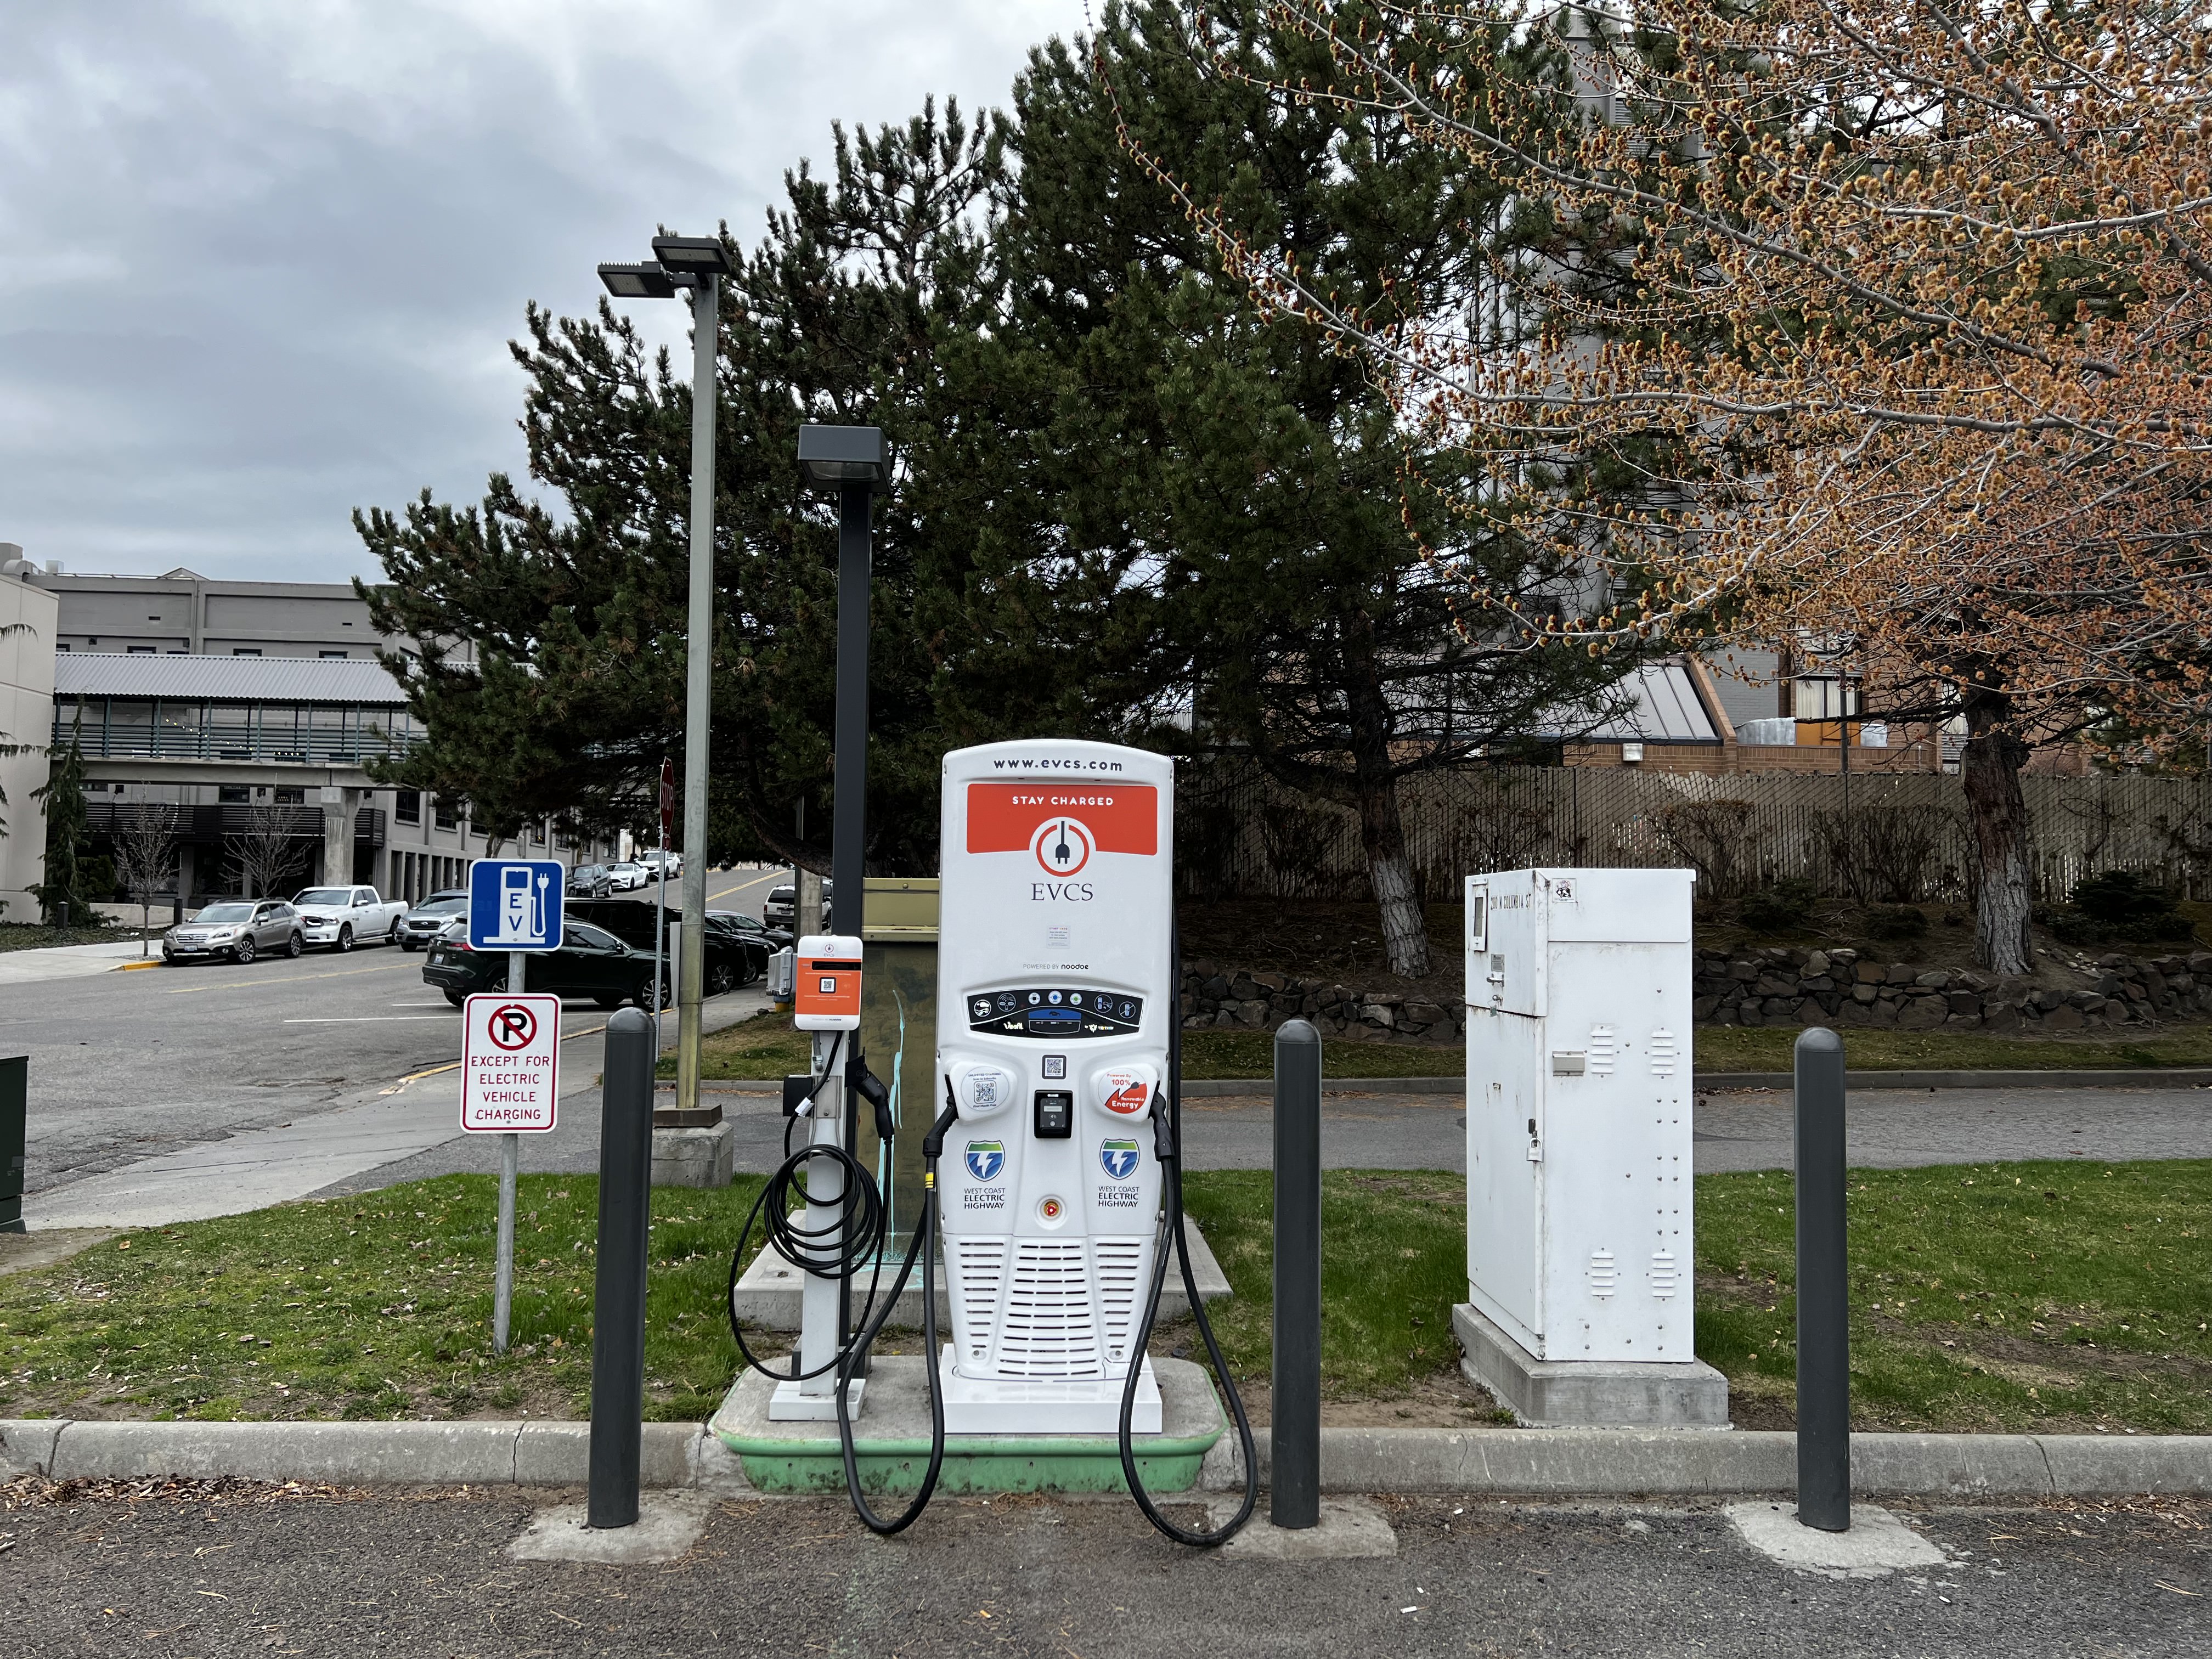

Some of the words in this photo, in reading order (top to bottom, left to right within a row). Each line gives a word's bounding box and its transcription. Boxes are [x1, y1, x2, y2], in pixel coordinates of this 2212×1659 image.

[994, 759, 1122, 771] www.evcs.com
[661, 781, 673, 811] STOP
[1012, 796, 1045, 805] STAY
[1051, 797, 1114, 806] CHARGED
[1031, 883, 1093, 901] EVCS
[1499, 896, 1502, 909] N
[1504, 895, 1523, 909] COLUMBIA
[1526, 893, 1531, 909] ST
[471, 1056, 518, 1066] EXCEPT
[526, 1056, 550, 1066] FOR
[479, 1074, 540, 1084] ELECTRIC
[483, 1091, 536, 1102] VEHICLE
[1111, 1101, 1138, 1109] Energy
[476, 1109, 541, 1120] CHARGING
